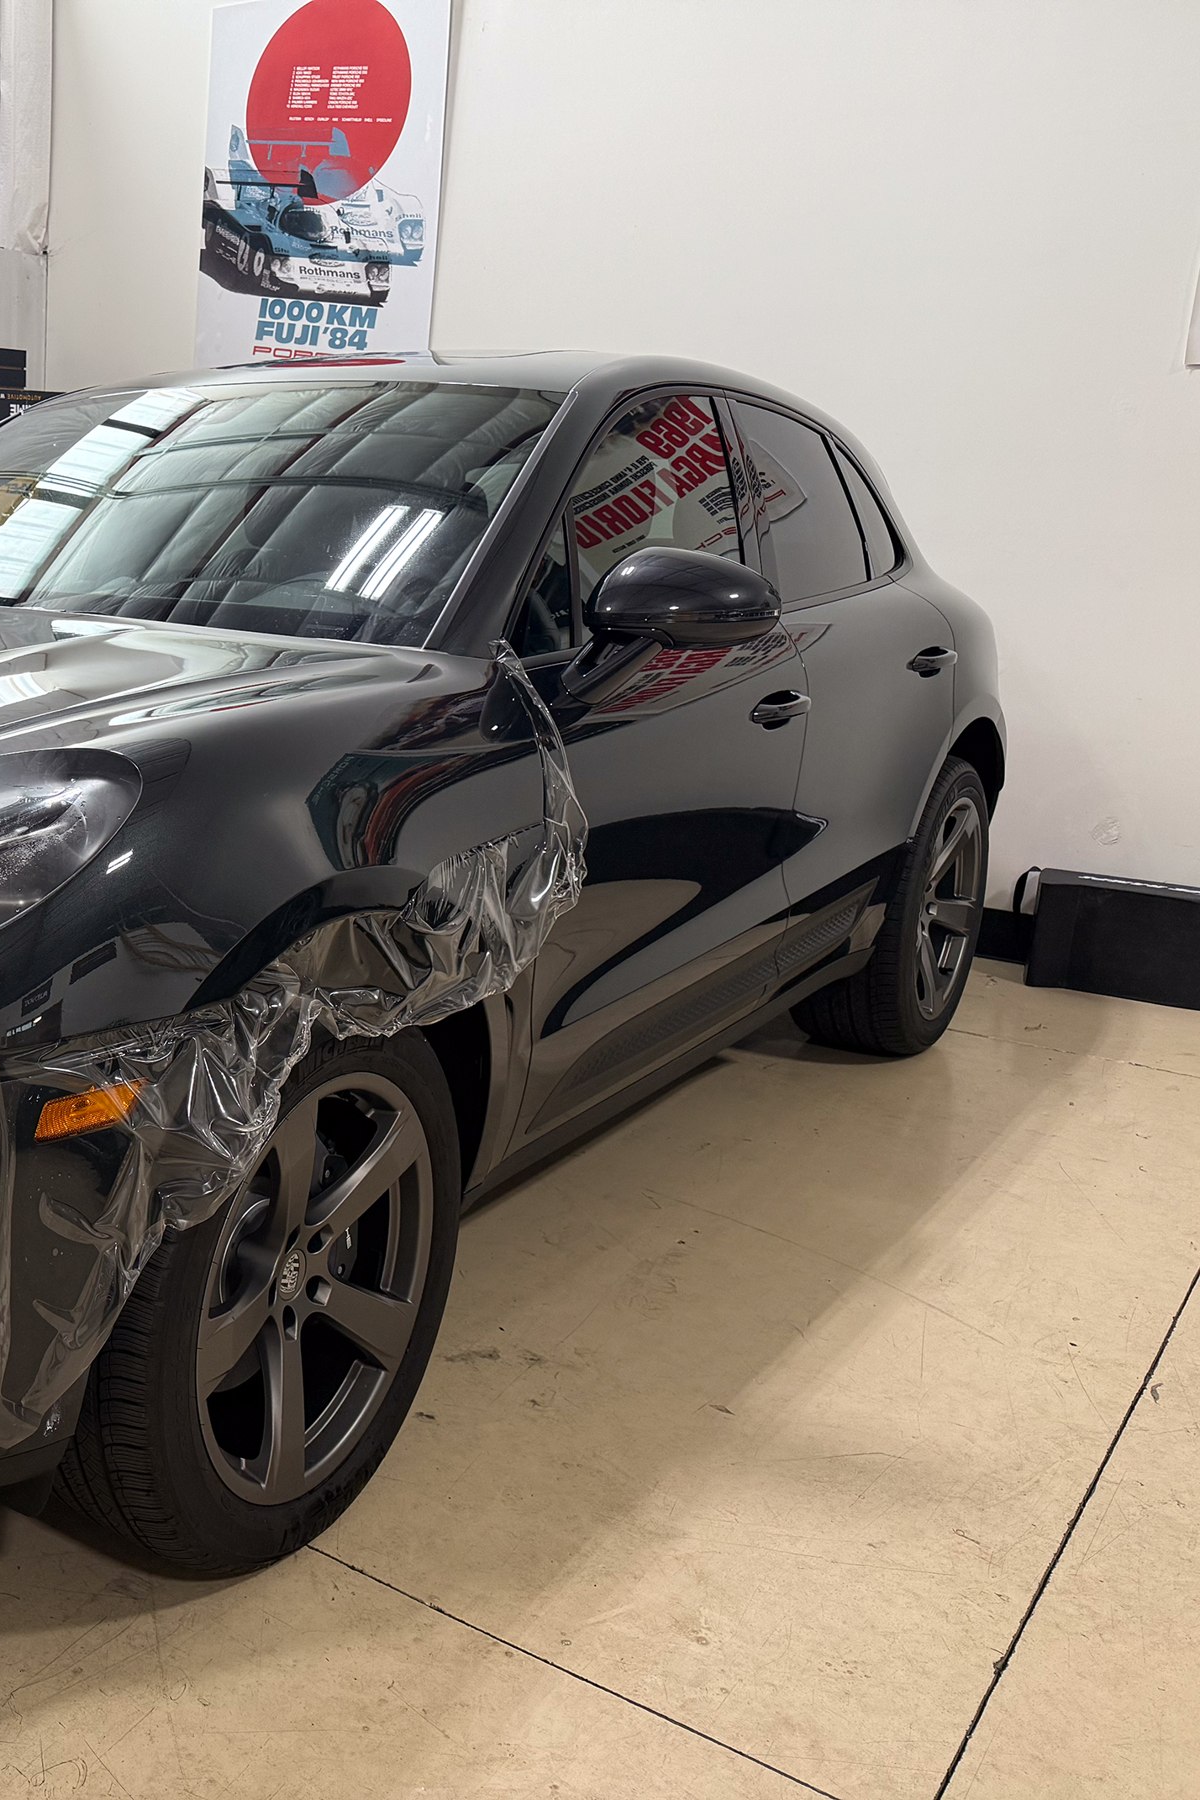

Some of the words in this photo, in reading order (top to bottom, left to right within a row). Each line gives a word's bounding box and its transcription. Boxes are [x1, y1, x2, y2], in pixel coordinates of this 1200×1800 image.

[299, 266, 361, 279] Rothmans
[259, 298, 324, 323] 1000
[326, 304, 378, 329] KM
[255, 321, 320, 346] FUJI
[322, 327, 368, 350] '84
[7, 393, 42, 401] AUTOMOTIVE
